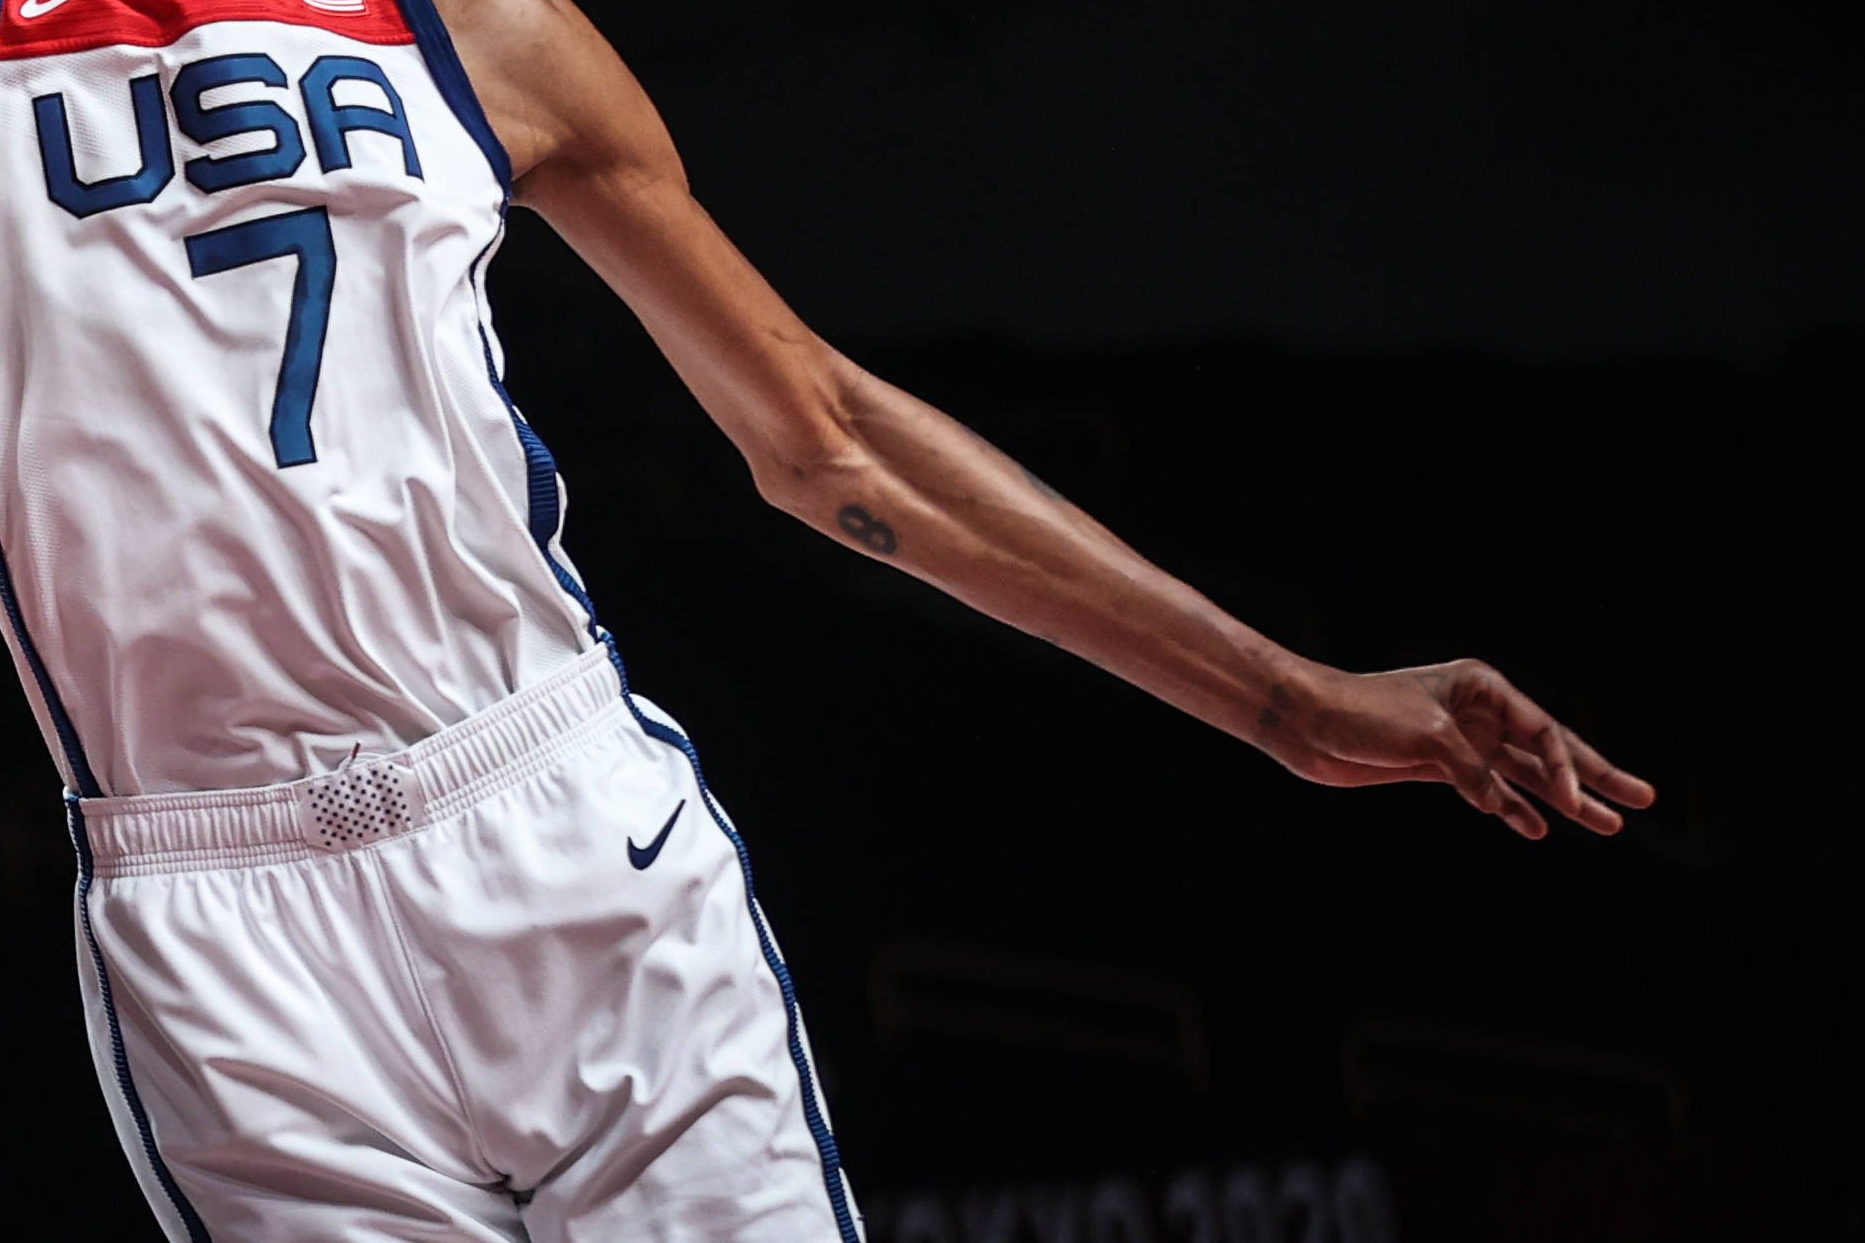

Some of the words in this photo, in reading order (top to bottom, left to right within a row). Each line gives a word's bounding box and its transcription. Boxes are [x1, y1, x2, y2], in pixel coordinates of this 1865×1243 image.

[32, 52, 425, 220] USA
[184, 206, 337, 470] 7
[869, 1176, 1150, 1243] OKYO
